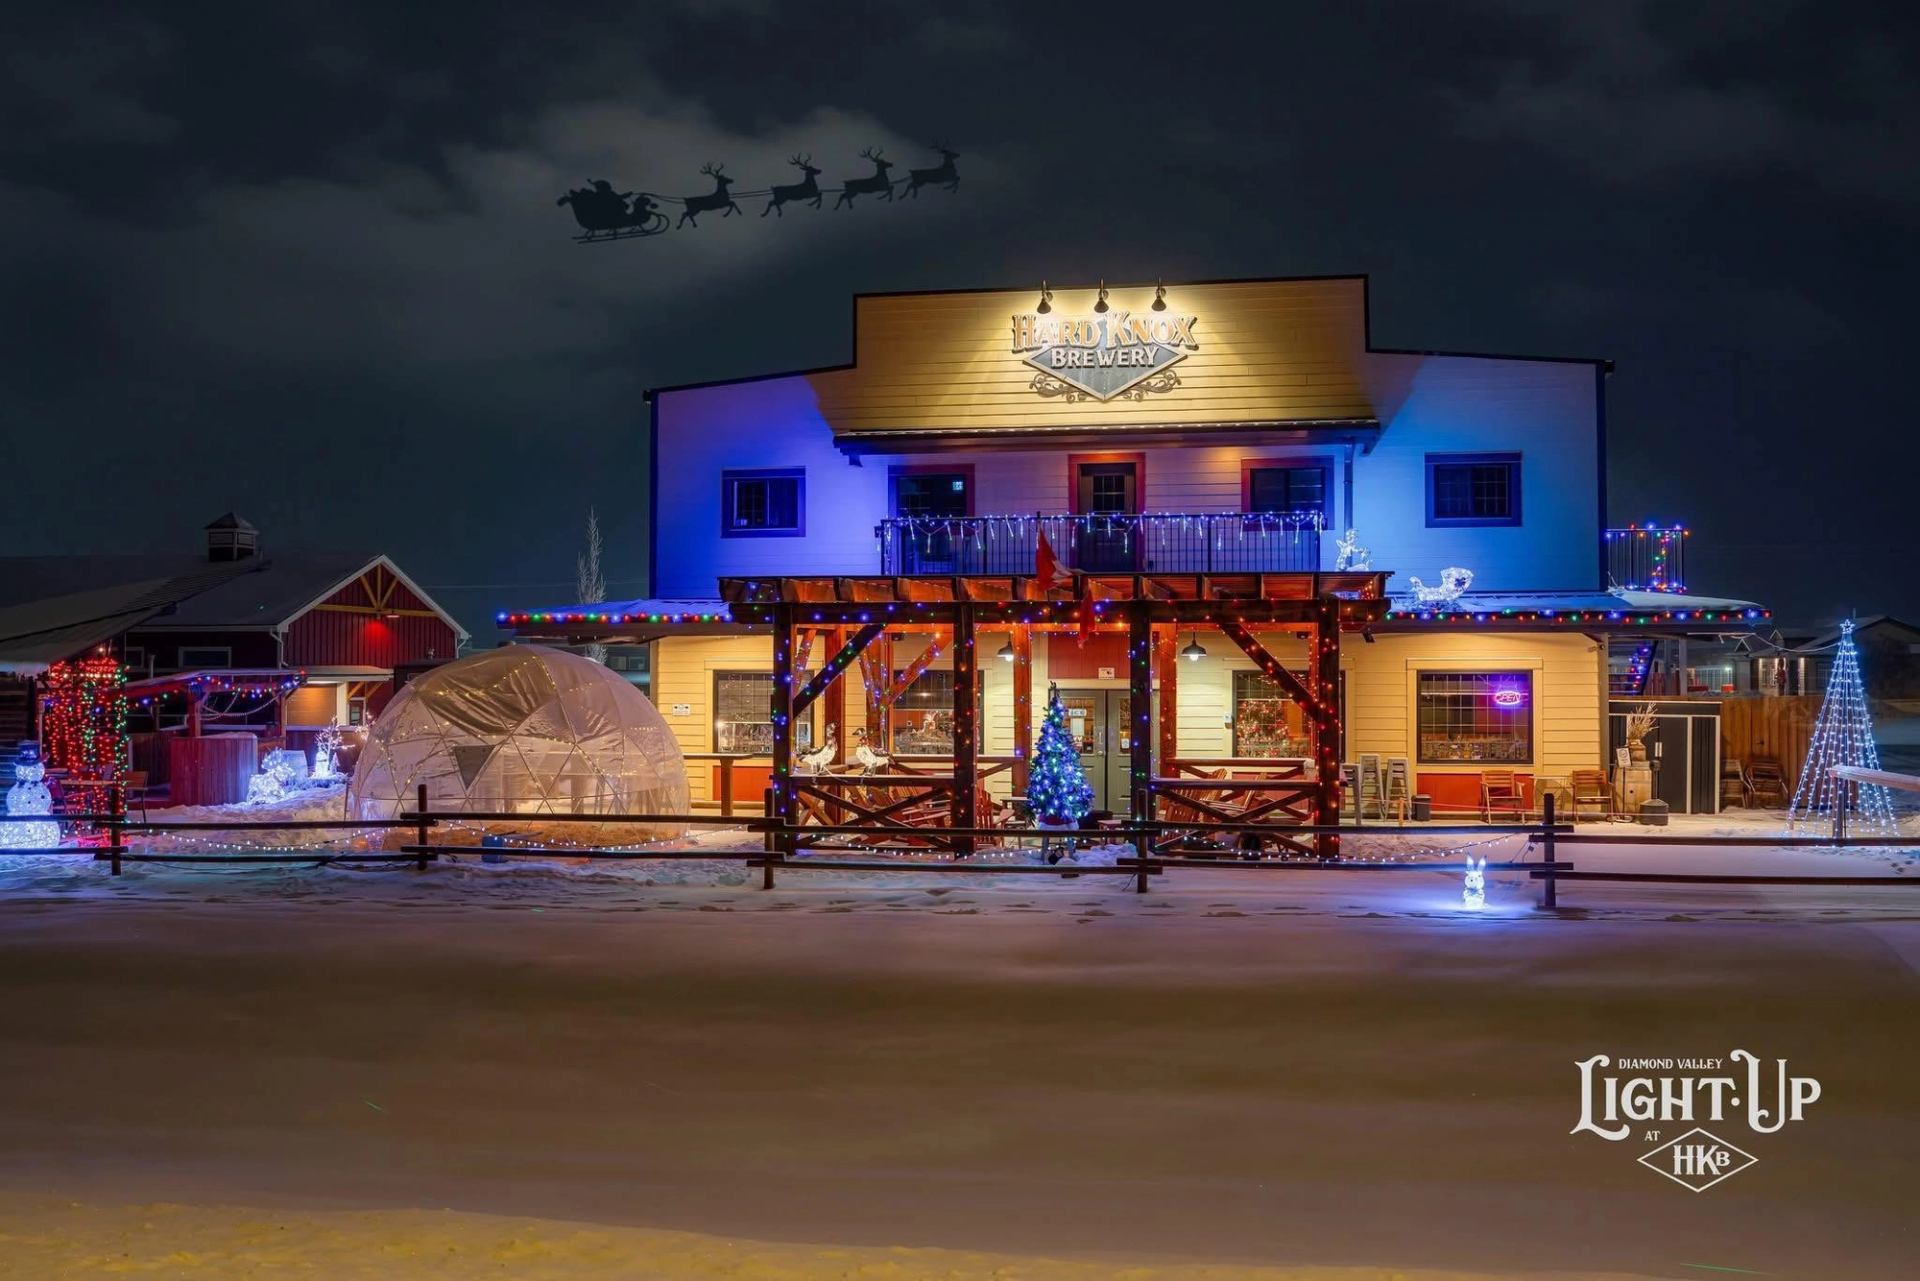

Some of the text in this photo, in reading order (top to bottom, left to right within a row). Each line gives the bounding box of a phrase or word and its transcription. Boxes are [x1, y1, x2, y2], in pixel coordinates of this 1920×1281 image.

[1012, 311, 1199, 352] HARD KNOX
[1050, 349, 1159, 368] BREWERY
